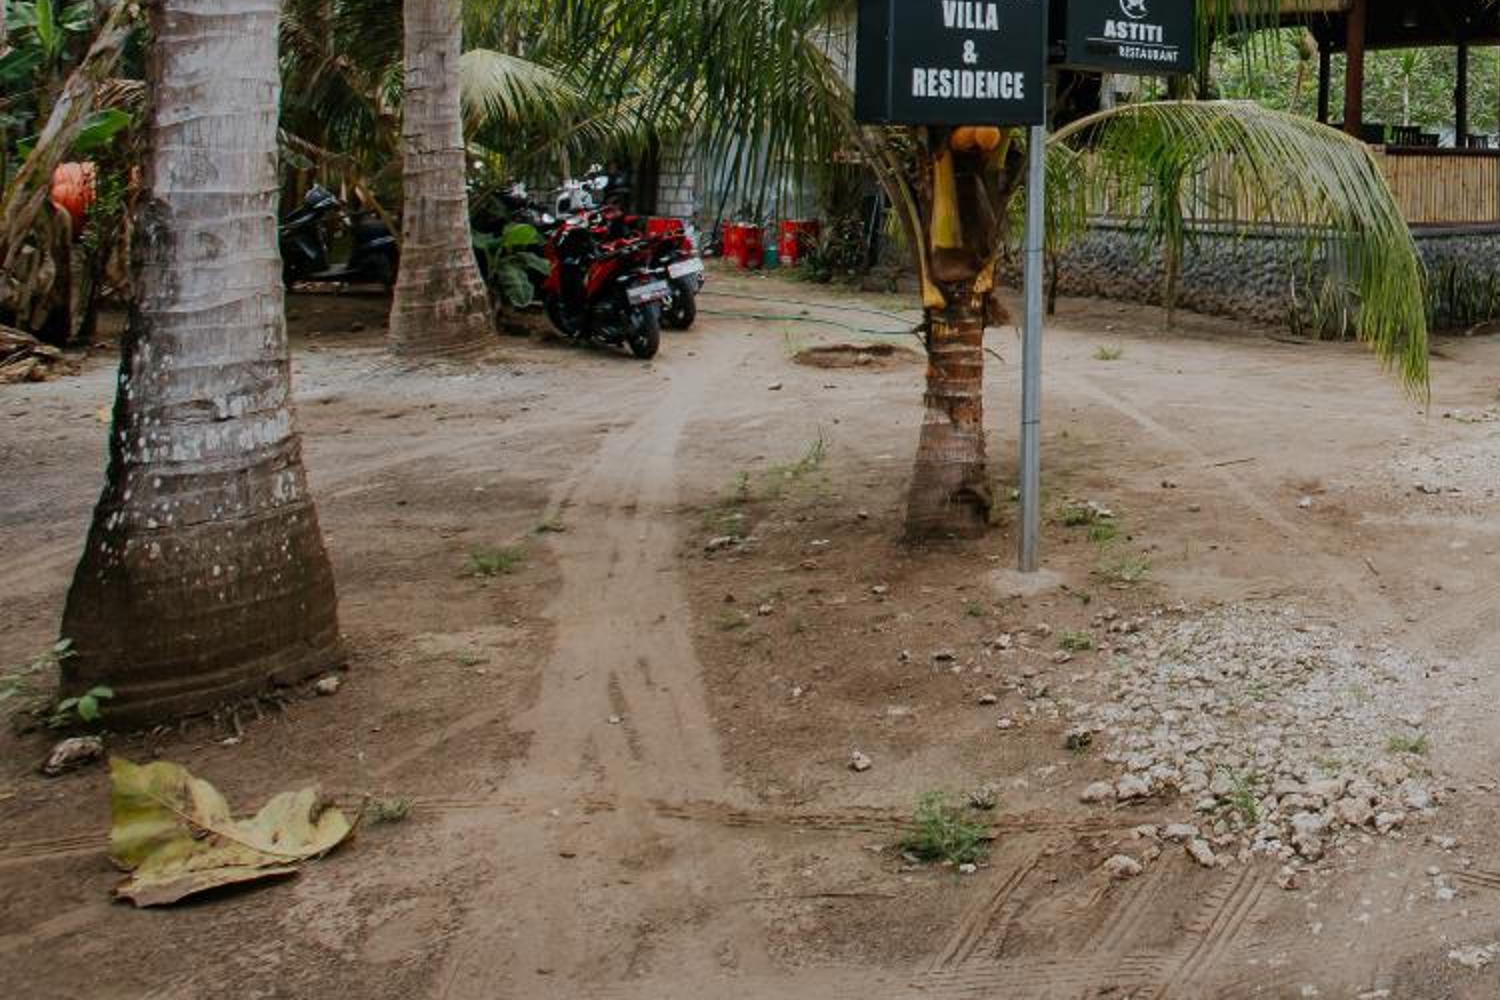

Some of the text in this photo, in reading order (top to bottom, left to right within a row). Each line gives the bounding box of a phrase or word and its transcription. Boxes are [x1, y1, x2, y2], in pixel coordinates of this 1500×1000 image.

[942, 0, 999, 31] VILLA
[1103, 20, 1163, 43] ASTITI
[963, 40, 978, 63] &
[1119, 45, 1179, 63] RESTAURANT
[912, 68, 1024, 99] RESIDENCE
